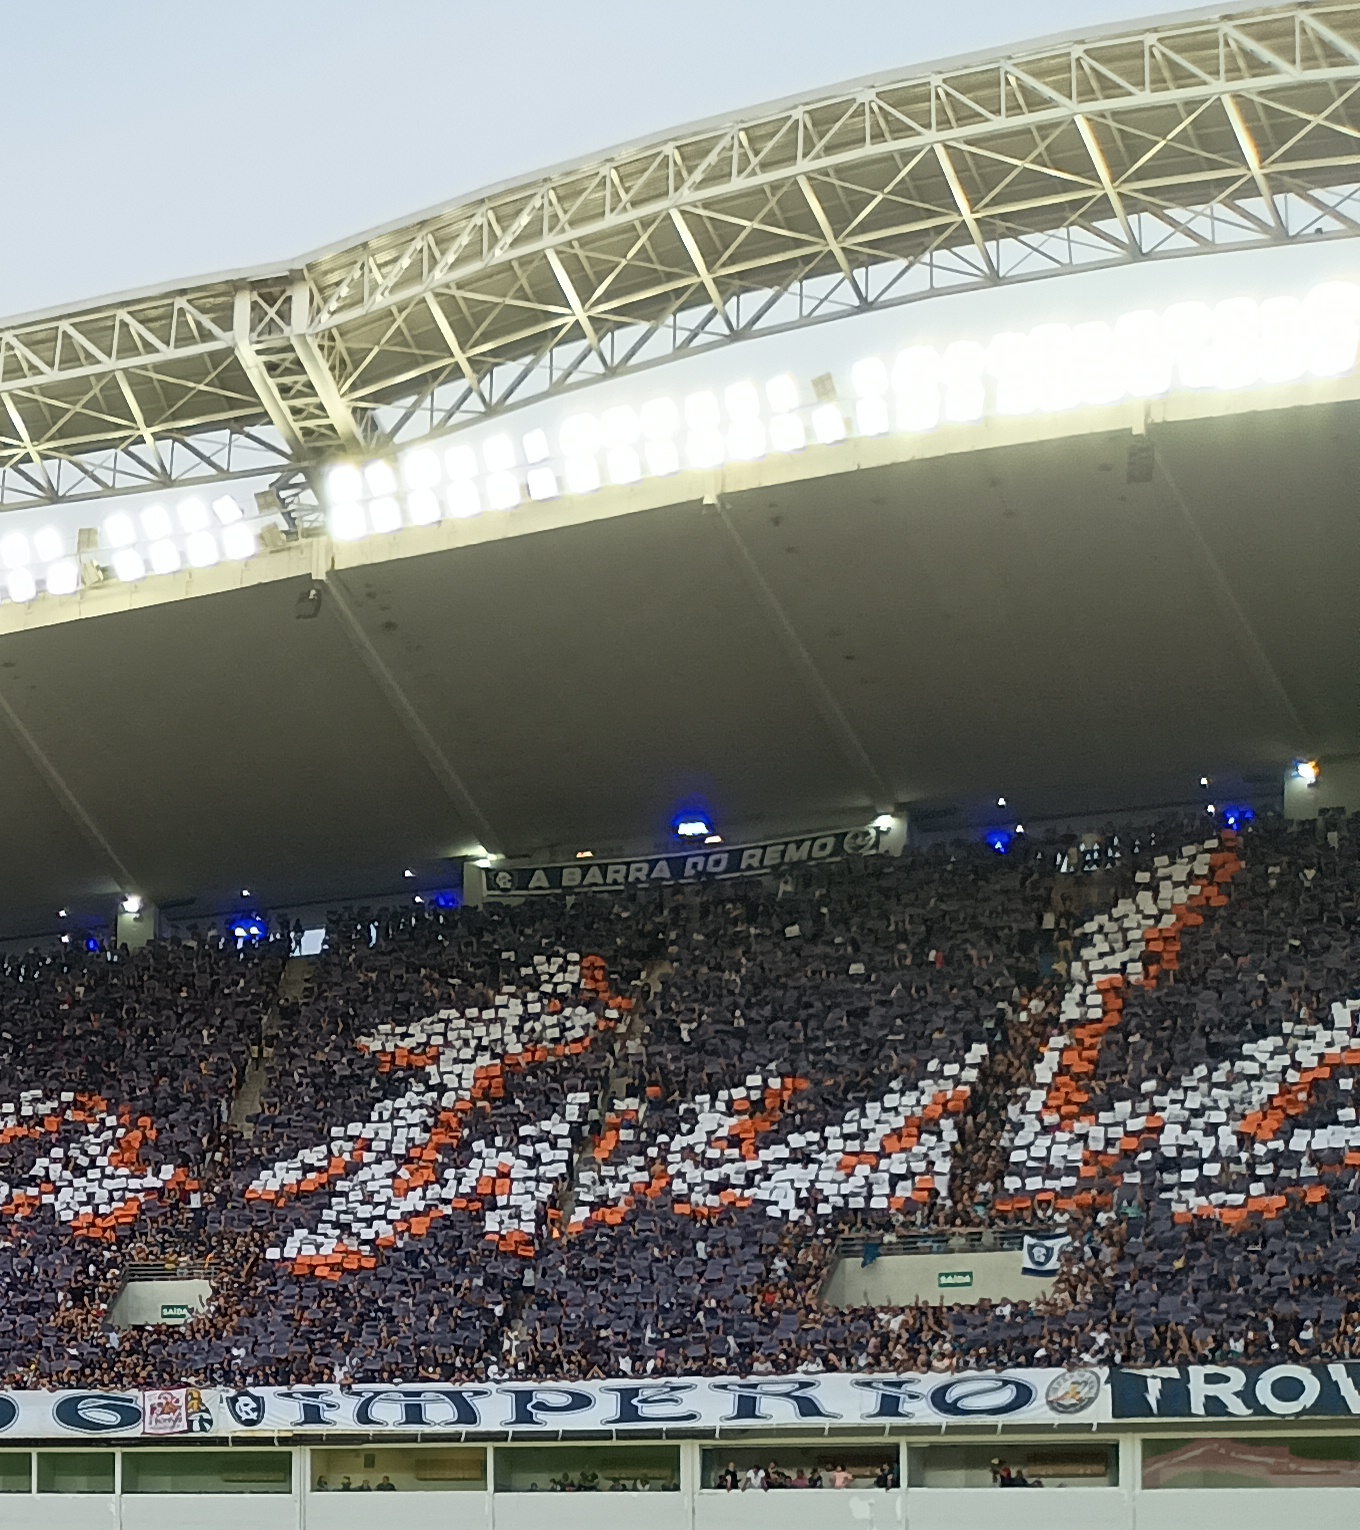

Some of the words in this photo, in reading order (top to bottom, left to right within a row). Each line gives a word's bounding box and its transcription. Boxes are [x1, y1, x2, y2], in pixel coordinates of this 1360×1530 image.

[527, 868, 550, 889] A
[561, 859, 671, 888] BARRA
[683, 852, 728, 877] DO
[739, 836, 835, 871] REMO
